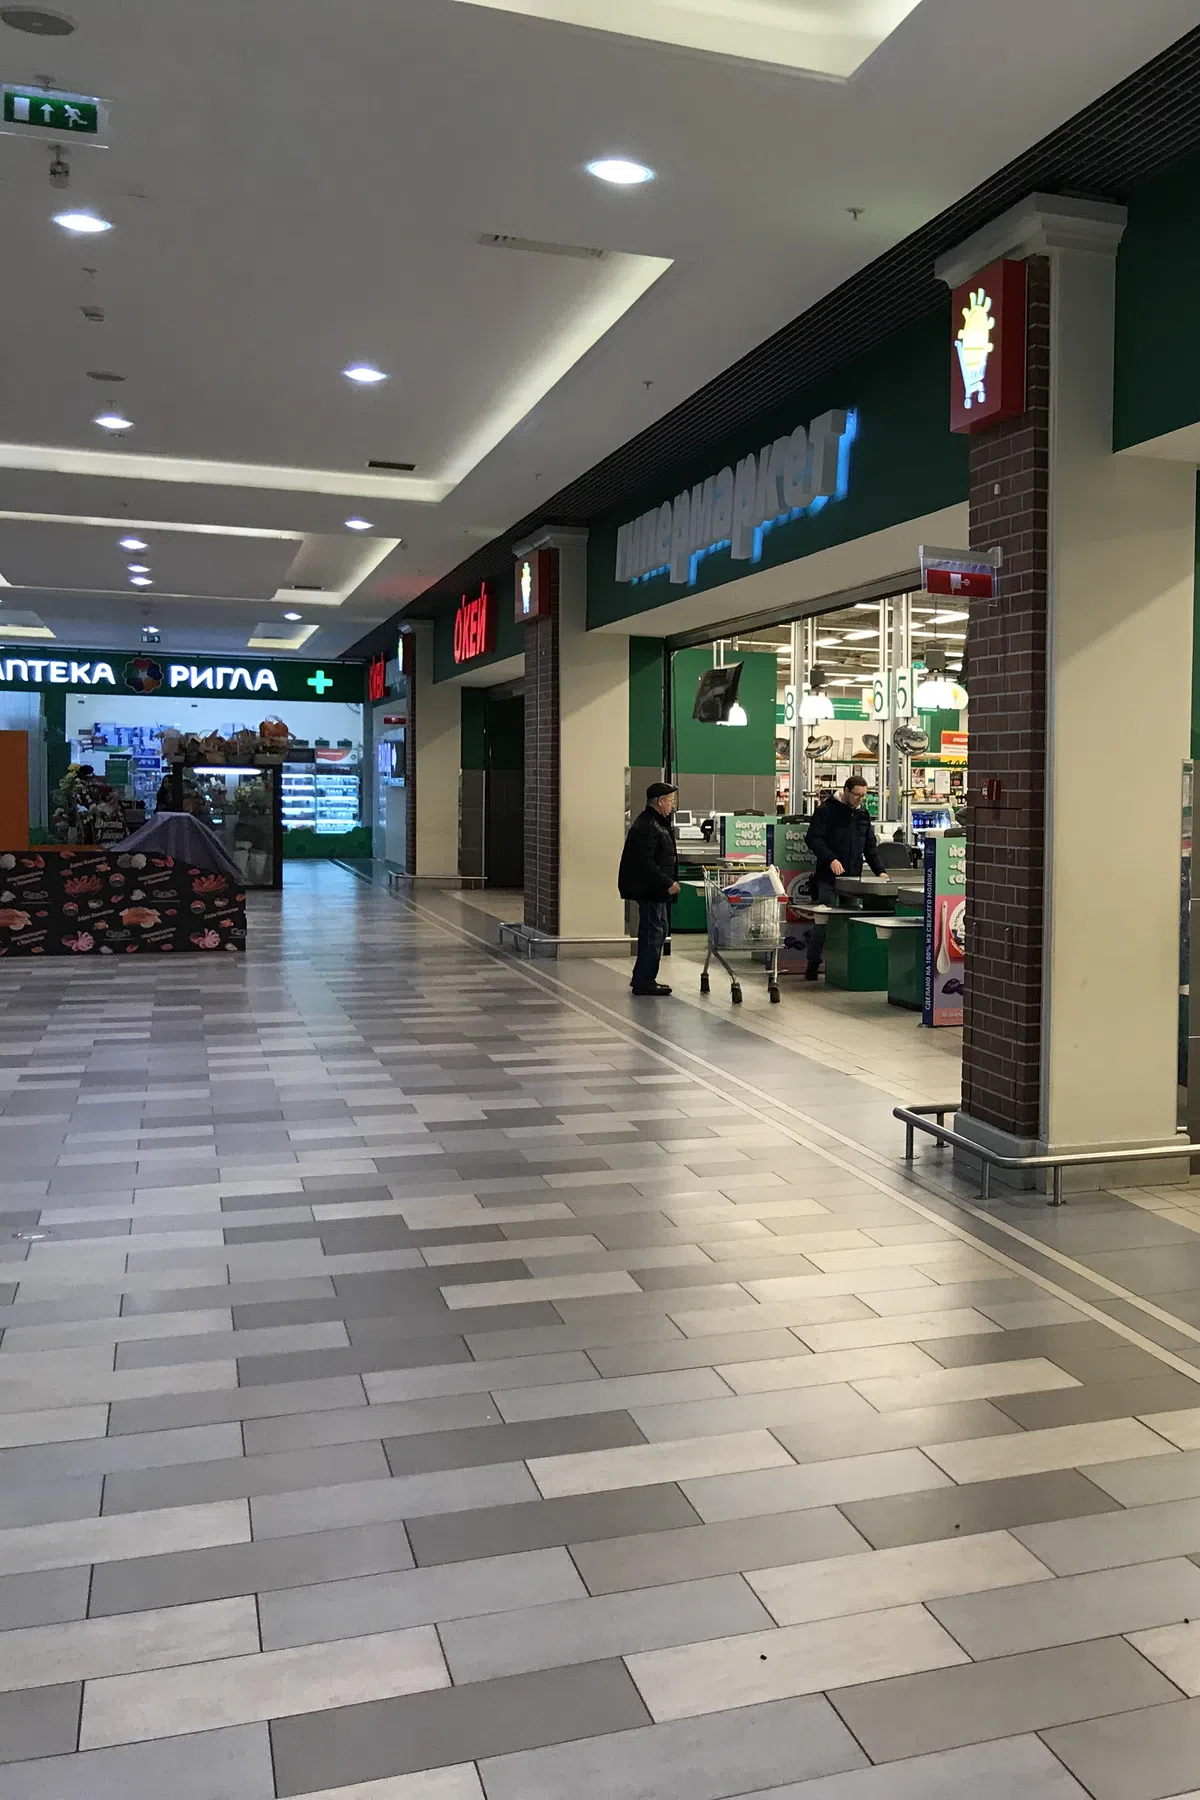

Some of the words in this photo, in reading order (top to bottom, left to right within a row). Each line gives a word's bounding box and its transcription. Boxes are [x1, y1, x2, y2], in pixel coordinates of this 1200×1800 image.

[170, 664, 278, 692] РИГЛА
[785, 692, 795, 721] 8
[874, 680, 884, 712] 6
